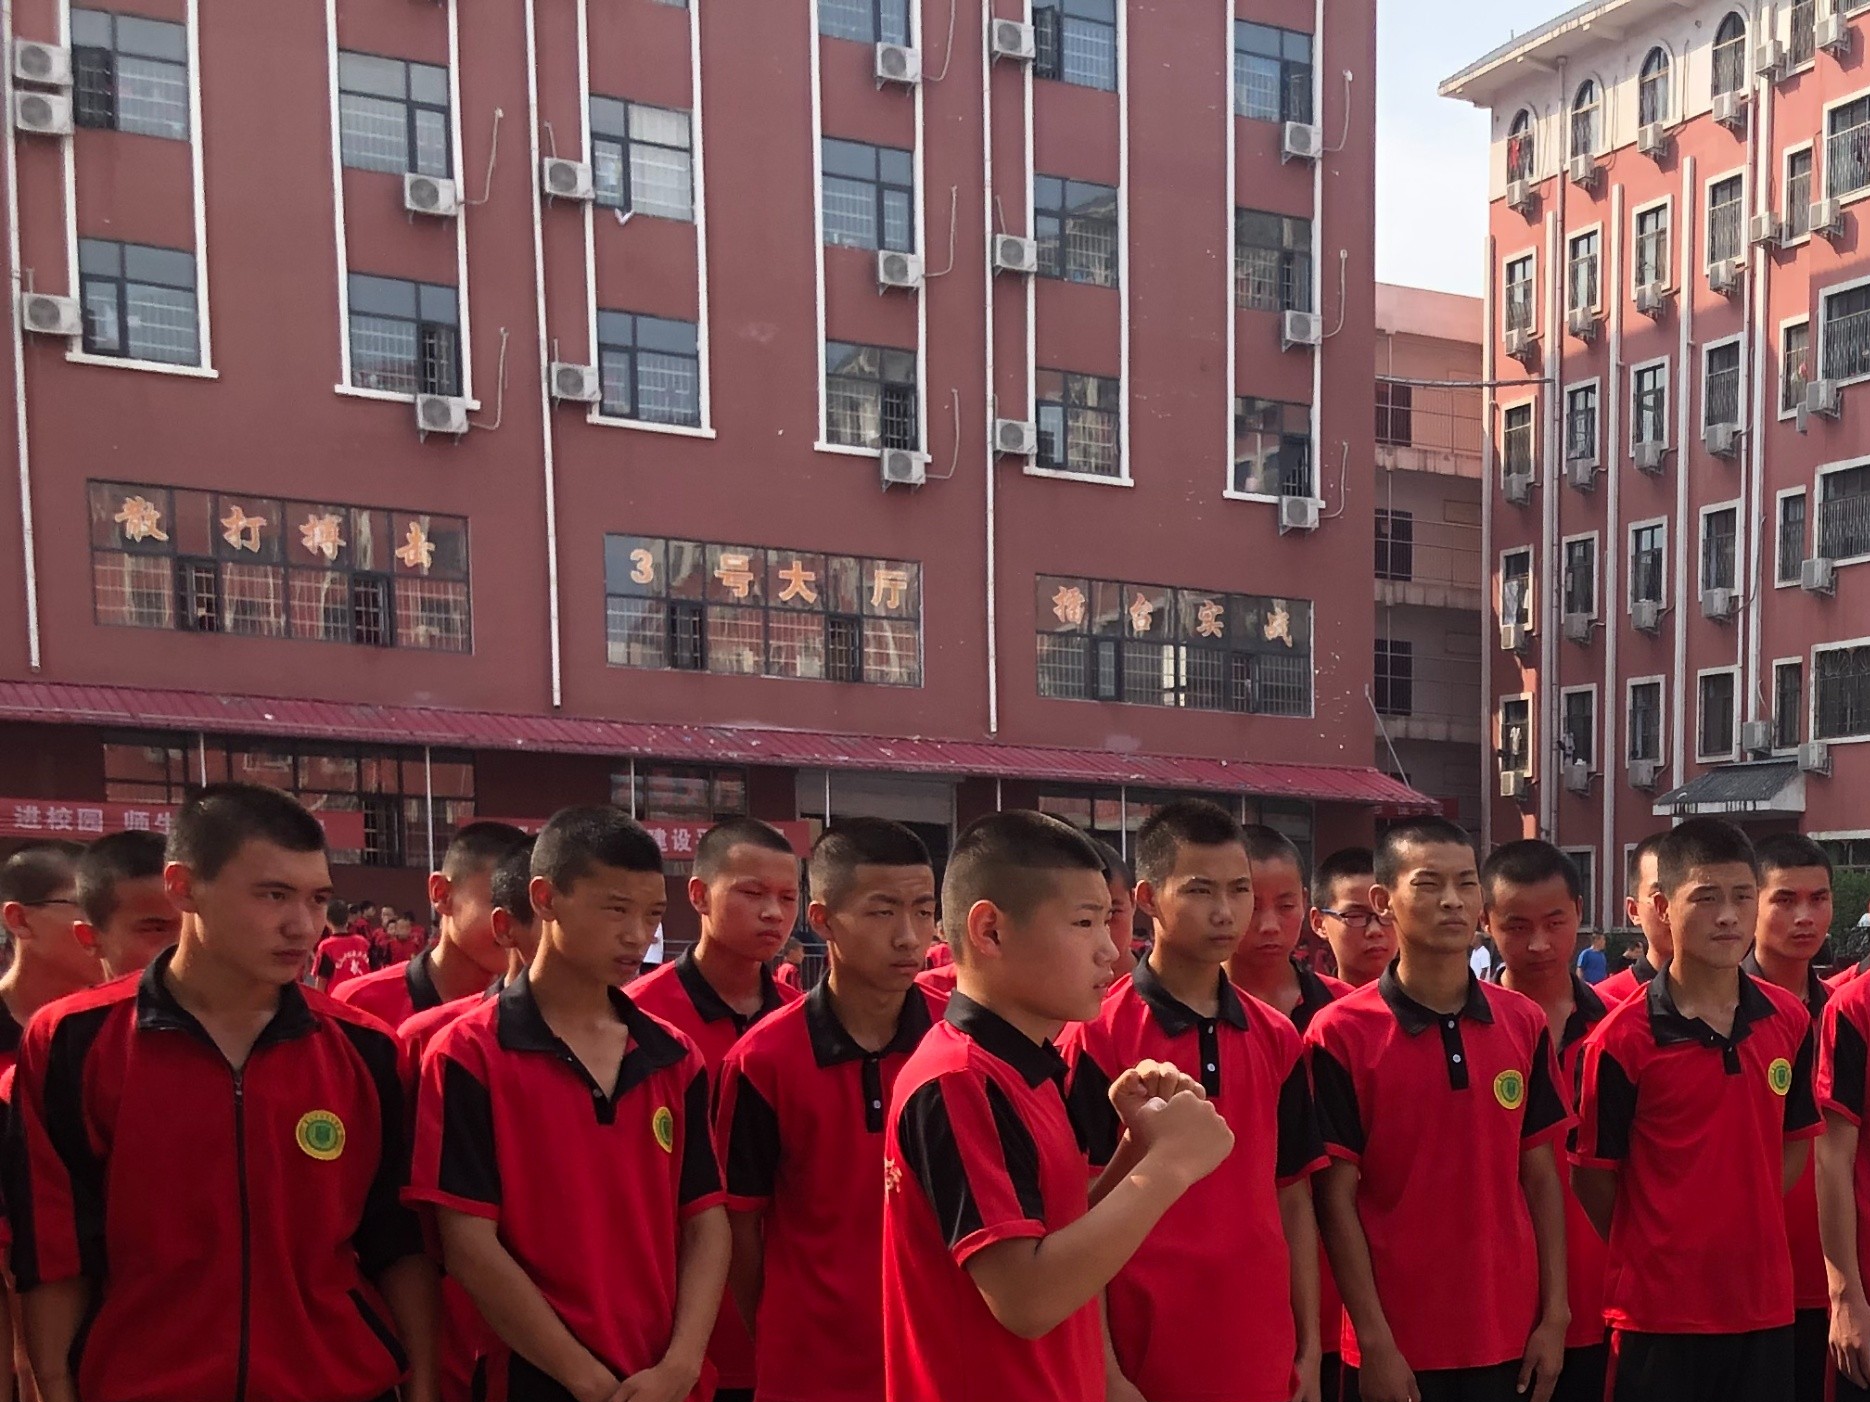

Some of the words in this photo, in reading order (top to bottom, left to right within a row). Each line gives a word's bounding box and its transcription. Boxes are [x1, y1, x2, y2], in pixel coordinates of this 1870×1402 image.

[114, 495, 436, 571] 散打搏击
[629, 548, 908, 609] 3号大厅
